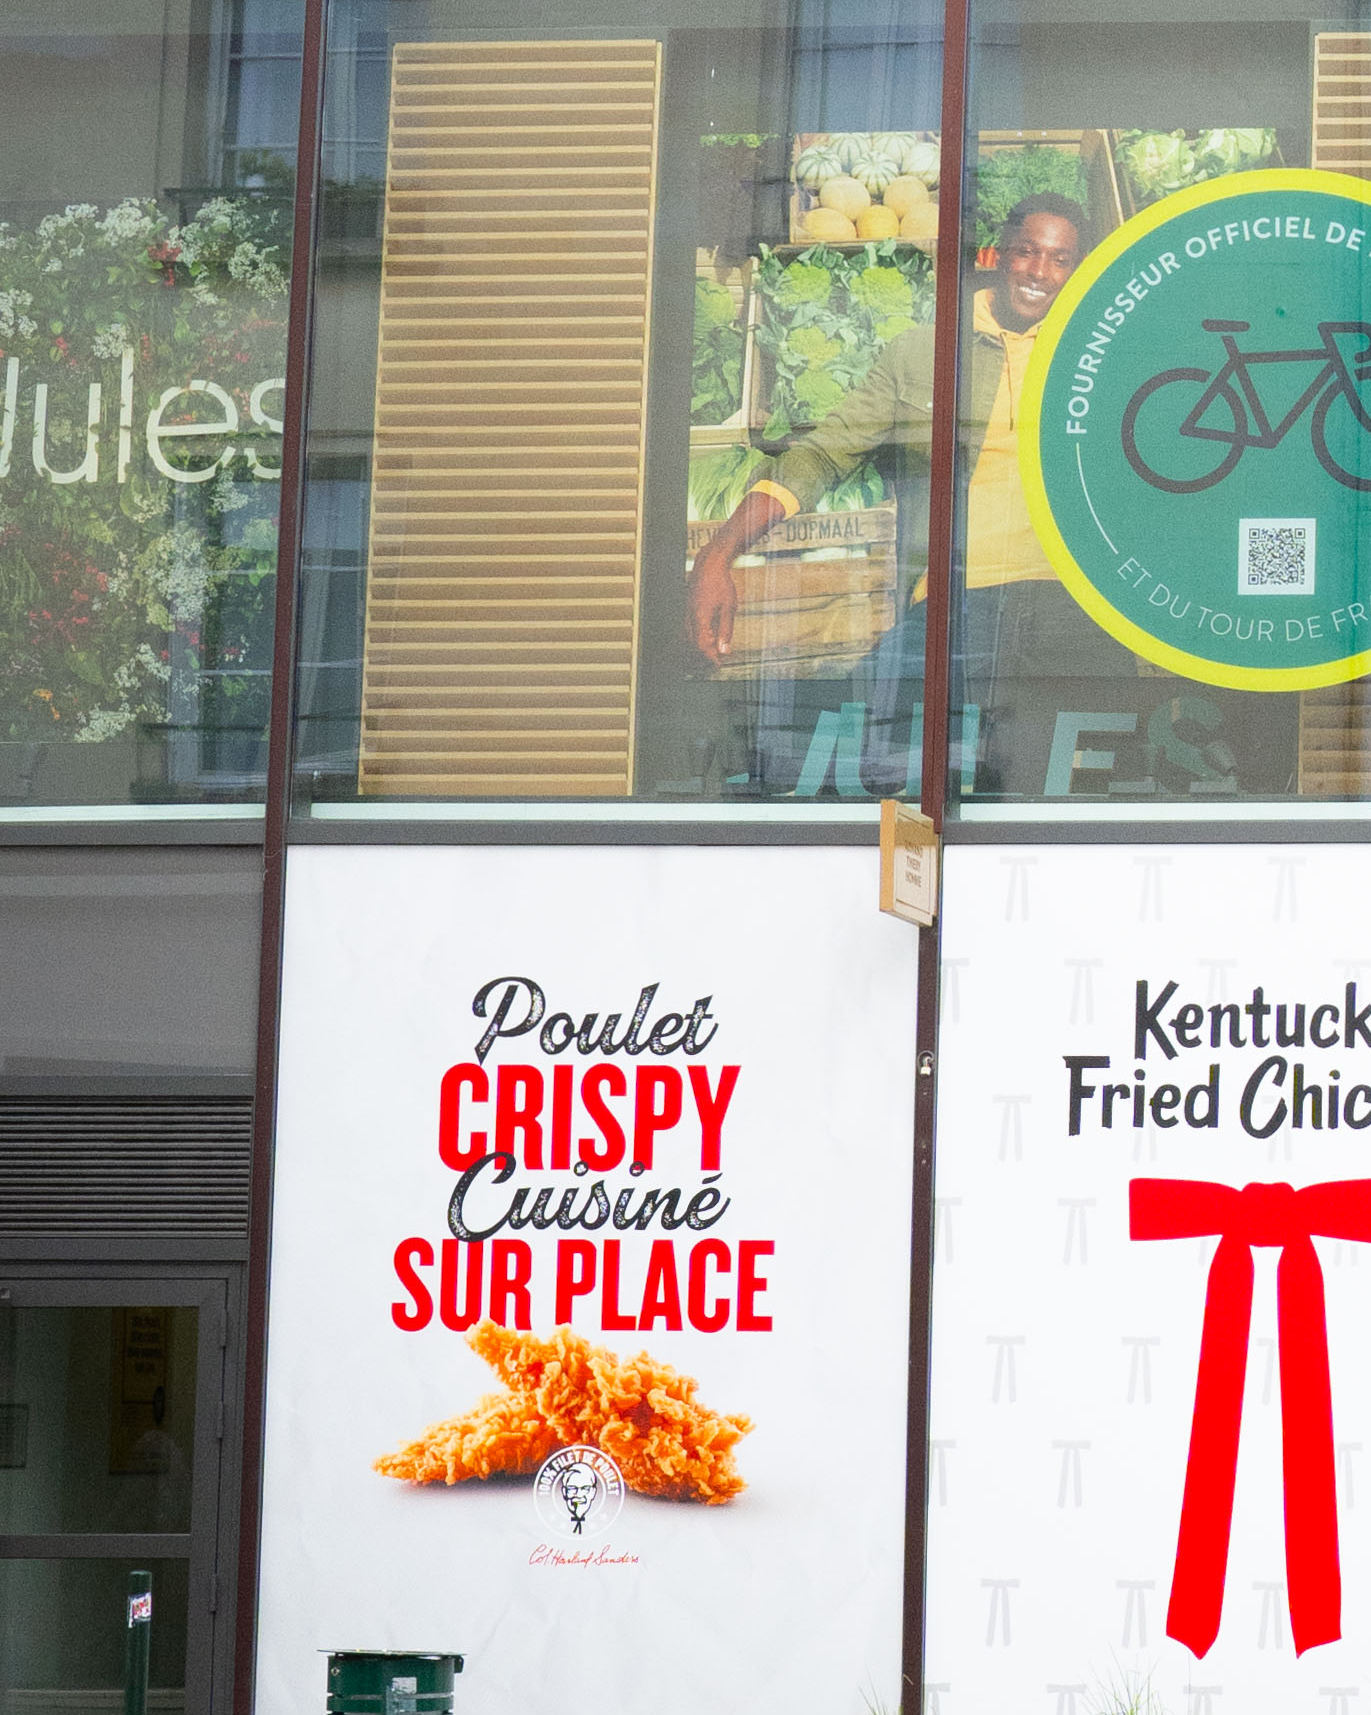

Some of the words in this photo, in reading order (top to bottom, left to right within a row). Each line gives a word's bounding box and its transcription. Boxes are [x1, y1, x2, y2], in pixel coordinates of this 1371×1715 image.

[1066, 252, 1181, 434] FOURNISSEUR
[1185, 216, 1316, 258] OFFICIEL
[1325, 221, 1366, 251] DE
[1117, 557, 1152, 588] ET
[1149, 583, 1191, 619] DU
[1197, 606, 1275, 641] TOUR
[1286, 616, 1323, 641] DE
[472, 976, 719, 1066] Poulet
[438, 1062, 742, 1172] CRISPY
[1063, 1055, 1220, 1136] Fried
[447, 1151, 732, 1243] Cuisiné
[391, 1237, 532, 1332] SUR
[555, 1238, 775, 1333] PLACE
[582, 1450, 597, 1462] DE
